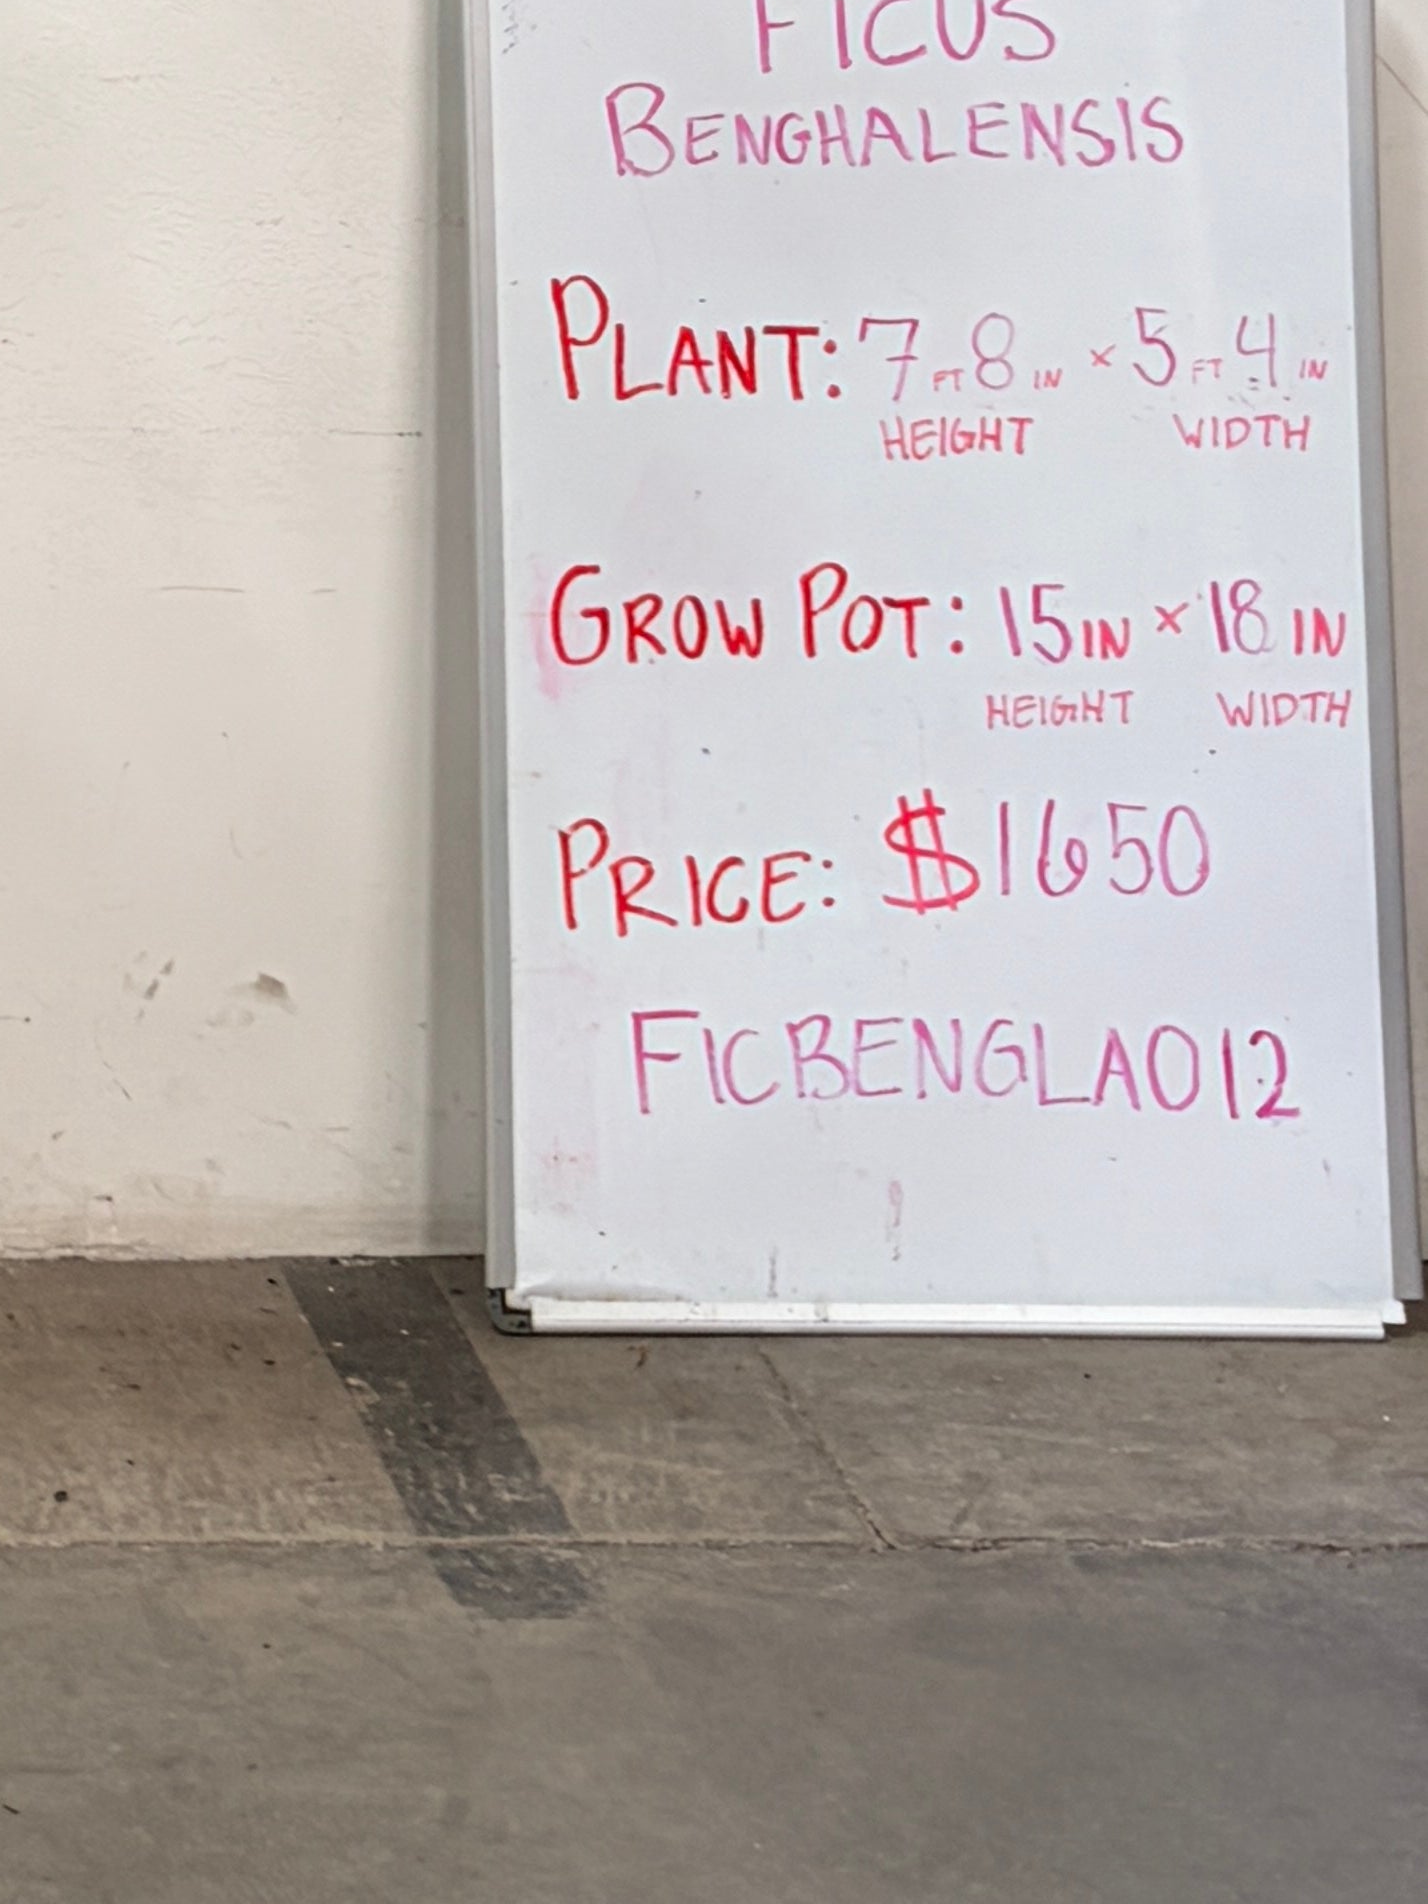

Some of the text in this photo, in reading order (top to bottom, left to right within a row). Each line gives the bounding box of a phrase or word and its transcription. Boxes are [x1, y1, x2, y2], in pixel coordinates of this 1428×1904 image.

[602, 80, 1186, 180] BENGHALENSIS
[548, 273, 842, 403] PLANT:
[857, 316, 921, 402] 7
[970, 312, 1015, 391] 8
[1132, 305, 1178, 388] 5
[1234, 313, 1278, 388] 4
[878, 411, 1312, 463] HEIGHT WIDTH
[546, 562, 766, 669] GROW
[797, 560, 966, 662] POT:
[984, 688, 1352, 732] HEIGHT WIDTH
[556, 787, 1212, 939] PRICE: $1650
